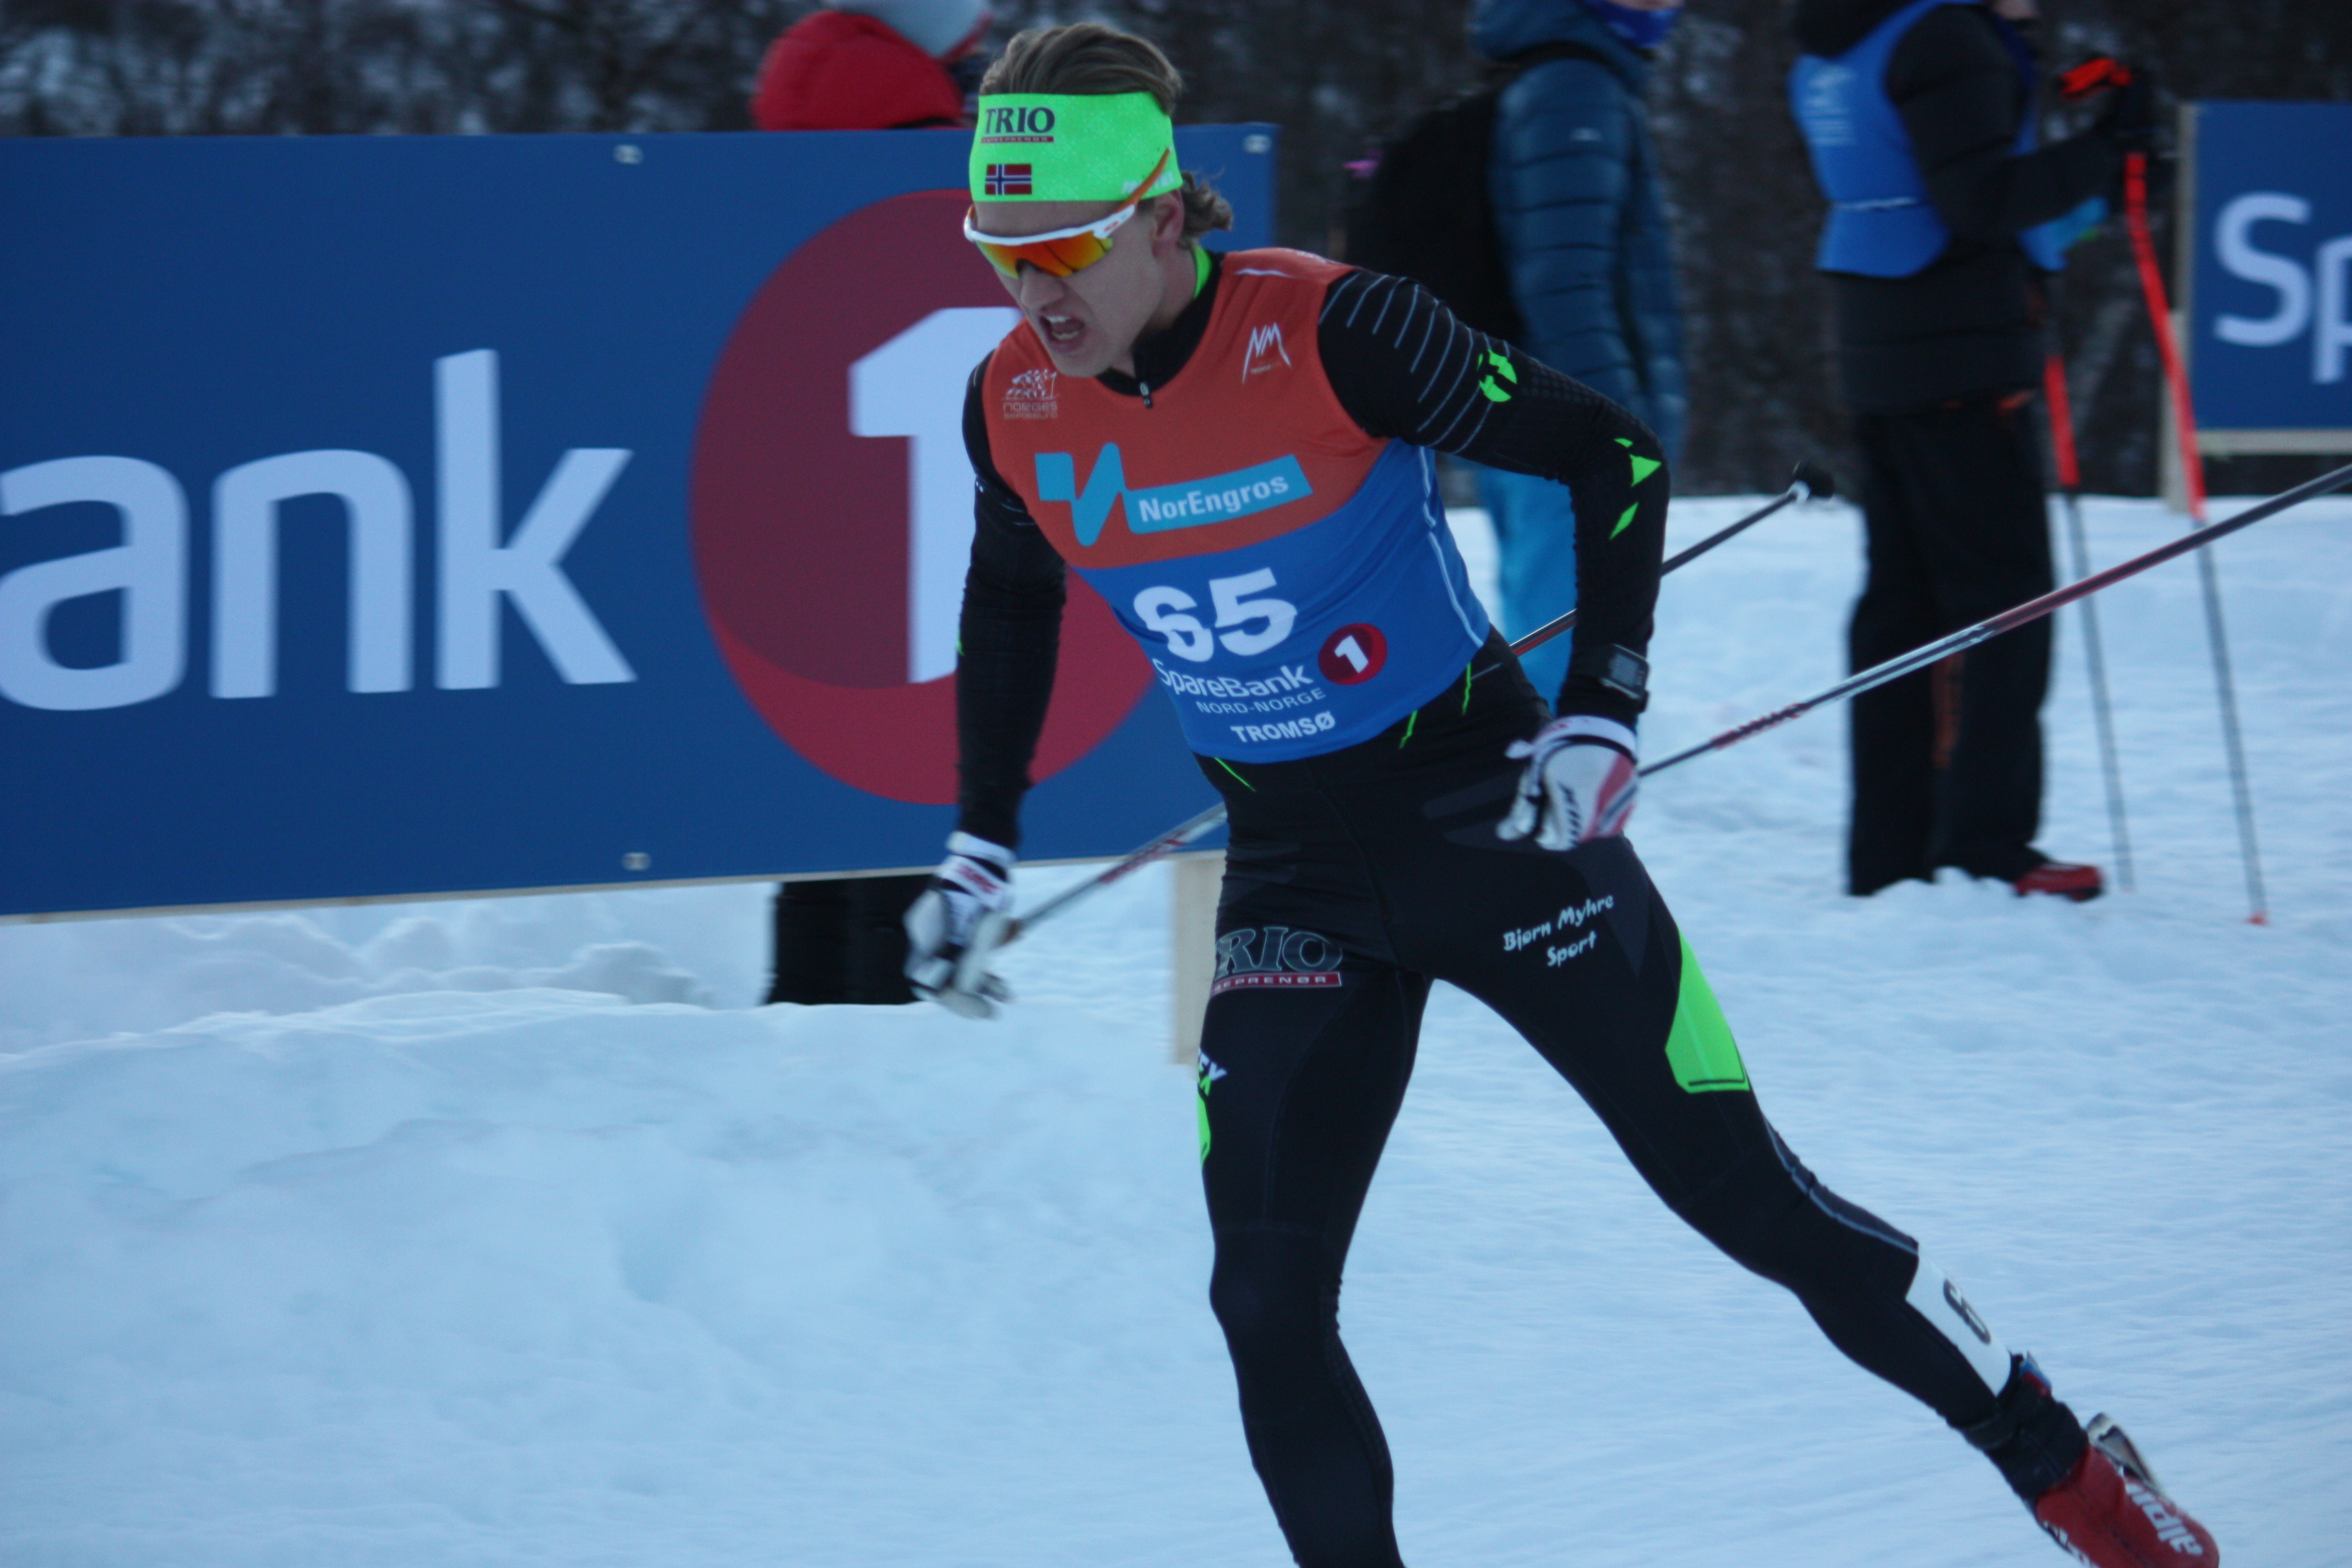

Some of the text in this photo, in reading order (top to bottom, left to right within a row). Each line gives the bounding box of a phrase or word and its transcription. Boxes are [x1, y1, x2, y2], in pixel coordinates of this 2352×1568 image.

[985, 106, 1056, 133] TRIO
[1139, 476, 1289, 522] NorEngros
[1134, 567, 1298, 662] 65
[1152, 635, 1369, 698] SpareBank 1
[1196, 688, 1326, 714] NORD-NORGE
[1230, 710, 1336, 743] TROMSØ
[1556, 894, 1614, 930] Myhre
[1215, 926, 1343, 981] RIO
[1546, 930, 1597, 968] Sport
